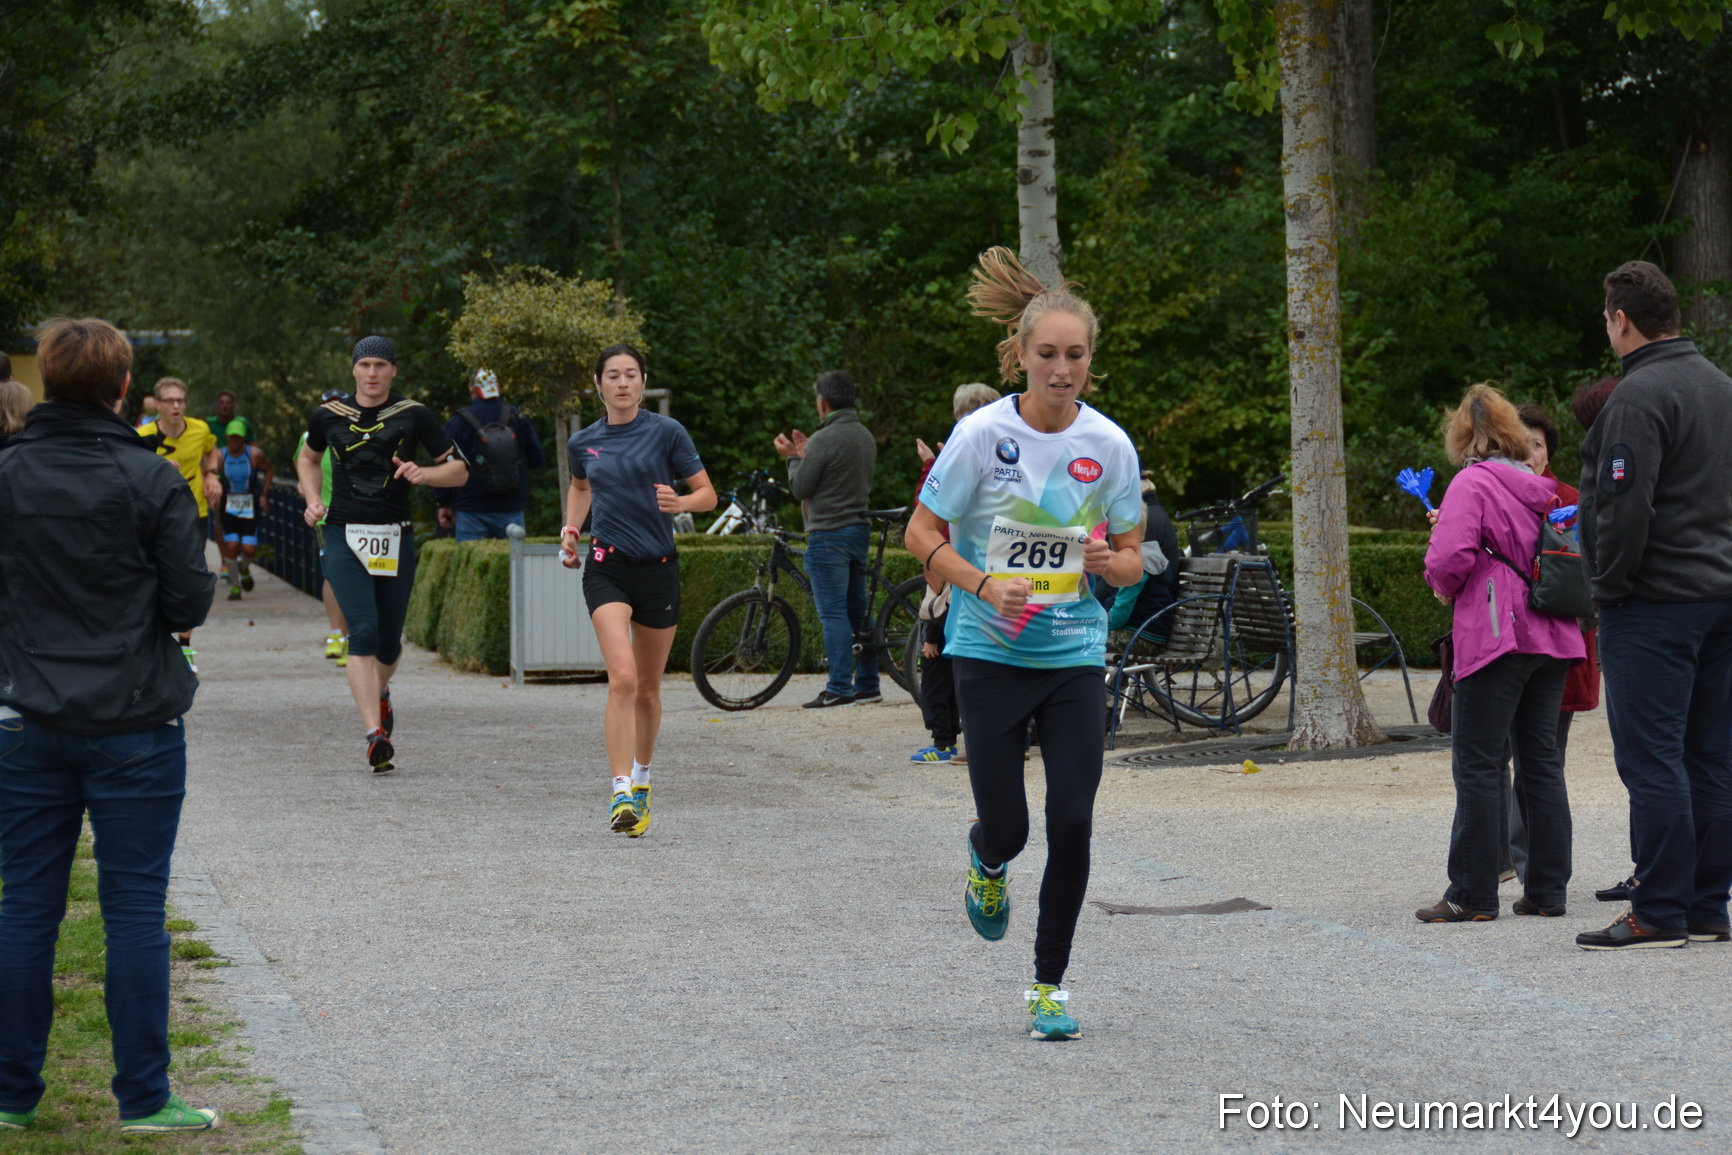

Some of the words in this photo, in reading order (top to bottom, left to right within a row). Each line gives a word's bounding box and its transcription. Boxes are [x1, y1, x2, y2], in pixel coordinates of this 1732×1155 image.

[994, 467, 1022, 478] PARTL
[994, 525, 1026, 538] PARTL
[1029, 532, 1075, 542] Neumarkt
[358, 537, 390, 556] 209
[1007, 541, 1068, 569] 269
[1025, 577, 1050, 591] ina
[1052, 608, 1074, 618] 16.
[1052, 618, 1096, 626] Neumarkter
[1051, 626, 1087, 636] Stadtlauf
